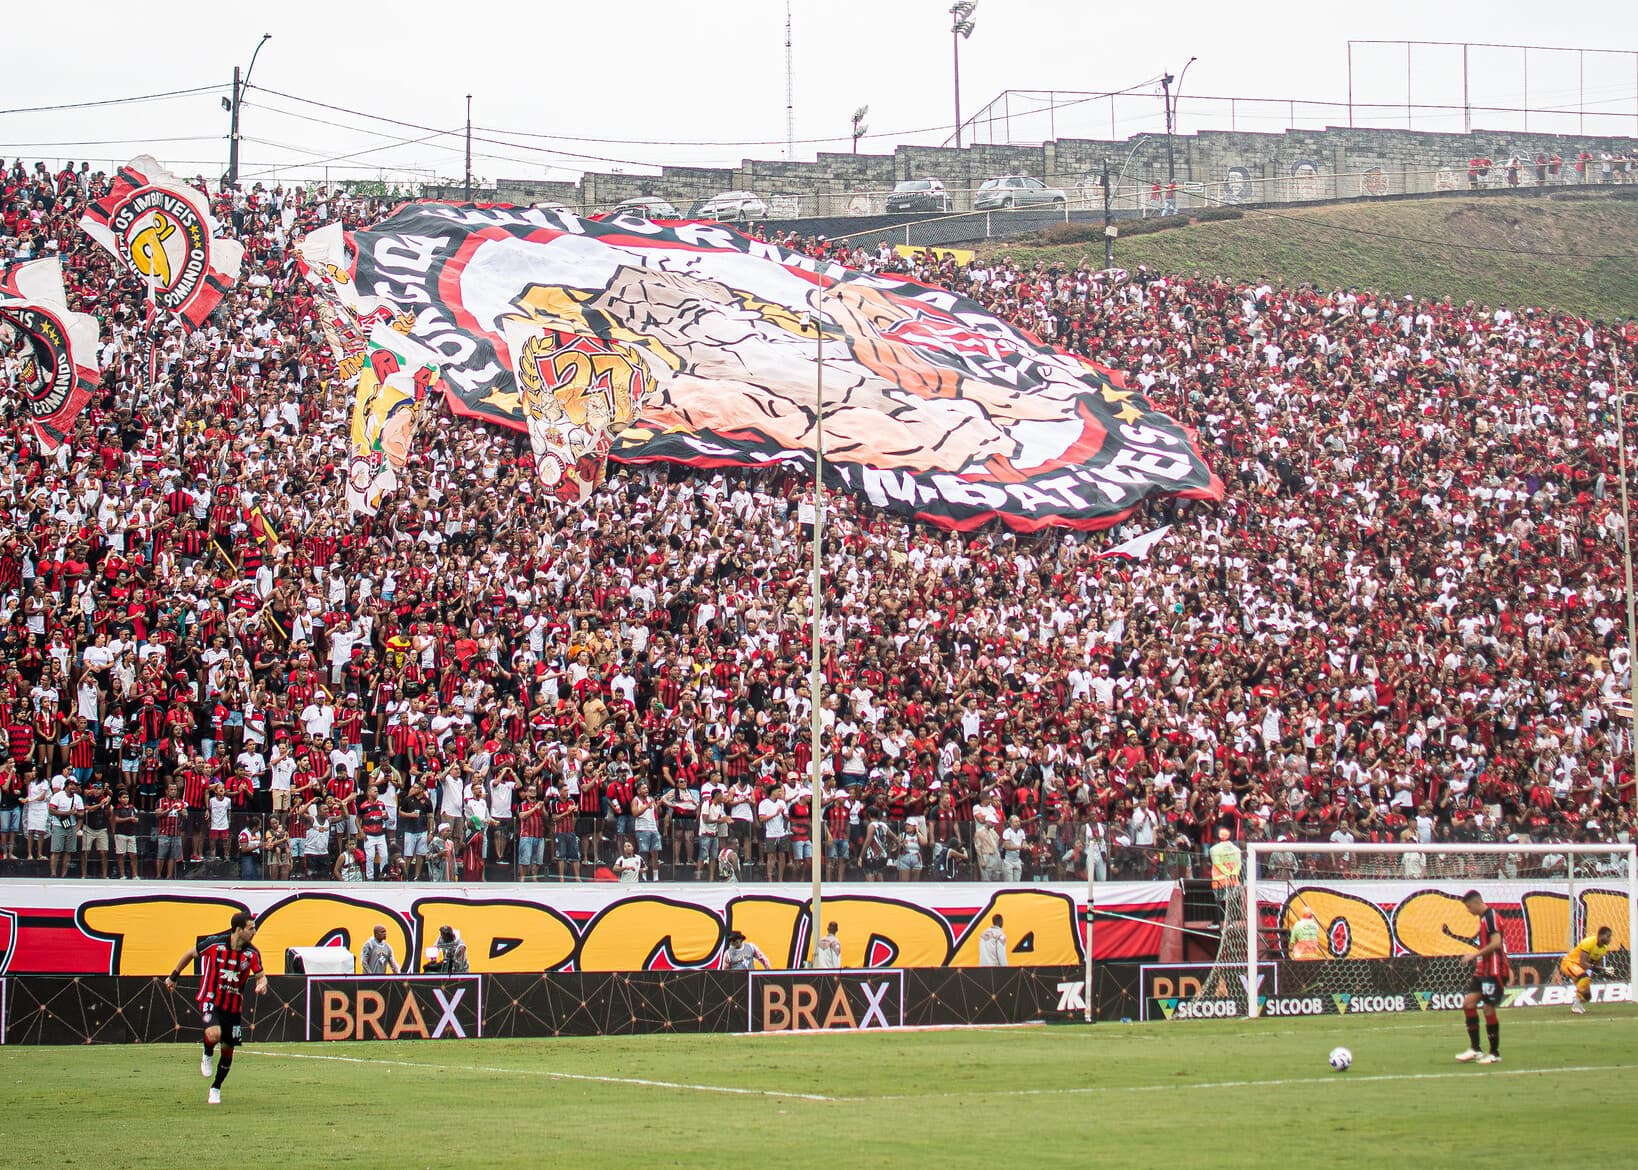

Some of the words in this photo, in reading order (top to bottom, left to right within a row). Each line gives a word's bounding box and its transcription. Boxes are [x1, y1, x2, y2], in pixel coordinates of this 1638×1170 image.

[115, 207, 135, 230] OS
[33, 353, 71, 416] COMANDO
[762, 982, 890, 1031] BRAX
[1056, 981, 1088, 1011] 7K
[1265, 998, 1323, 1016] SICOOB
[1350, 995, 1406, 1013] SICOOB
[1432, 991, 1484, 1010] SICO
[323, 987, 467, 1041] BRAX
[1176, 1000, 1237, 1019] SICOOB
